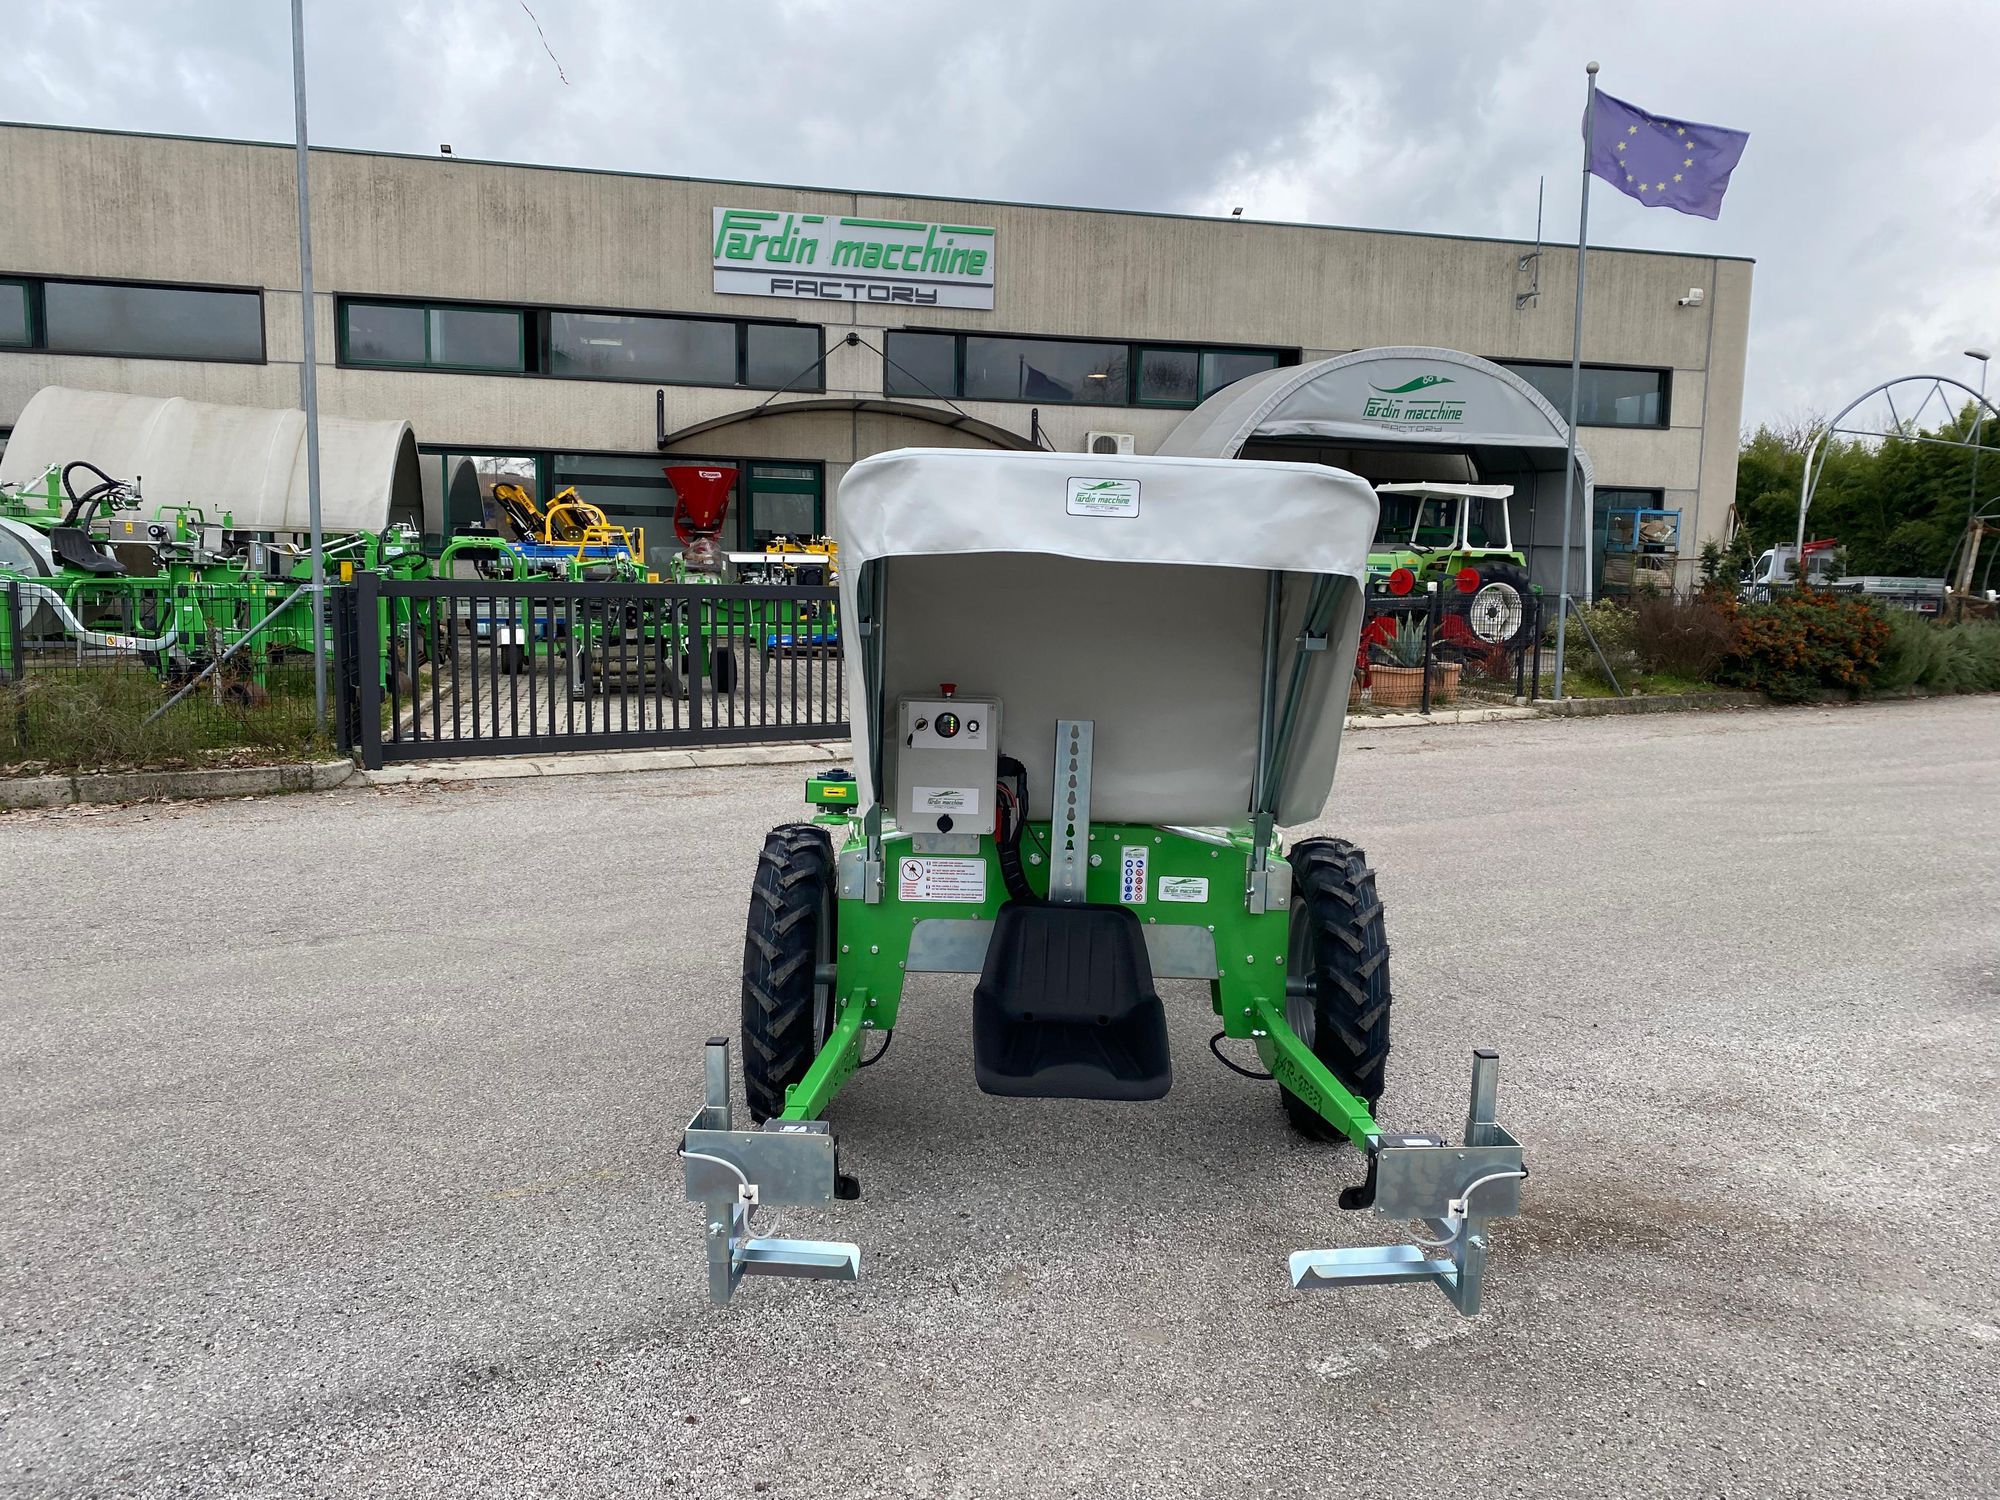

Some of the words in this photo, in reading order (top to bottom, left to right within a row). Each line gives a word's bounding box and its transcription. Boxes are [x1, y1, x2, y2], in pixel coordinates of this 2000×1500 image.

[714, 210, 824, 264] Fardin
[832, 217, 995, 275] macchine
[771, 278, 937, 304] FACTORY
[1363, 398, 1403, 418] Fardin
[1404, 401, 1466, 420] macchine
[1381, 423, 1442, 433] FACTORY
